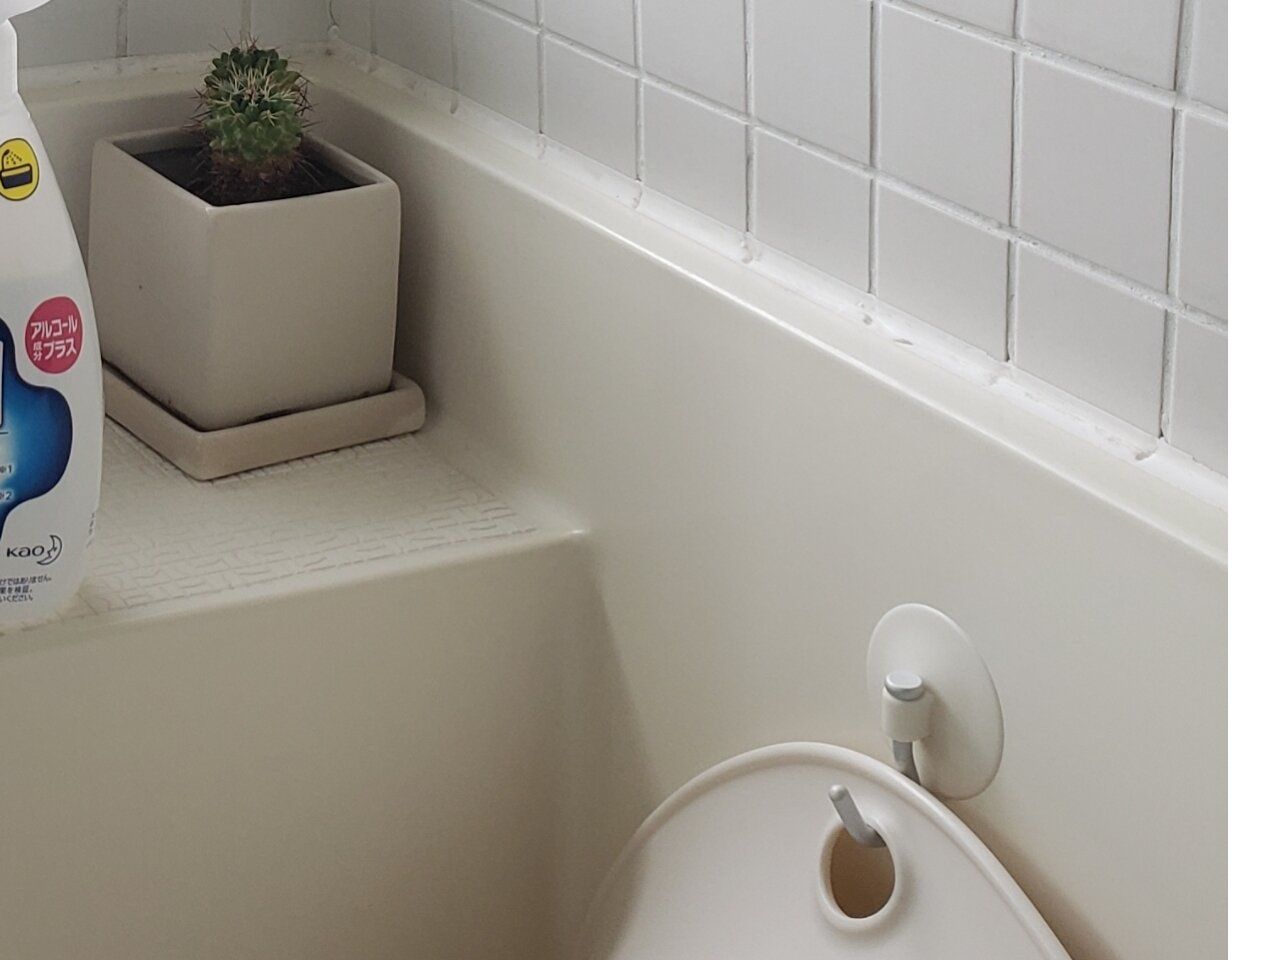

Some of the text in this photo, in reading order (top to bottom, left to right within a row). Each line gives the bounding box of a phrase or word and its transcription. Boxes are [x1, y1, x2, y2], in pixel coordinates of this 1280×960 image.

[30, 314, 78, 340] アルコール
